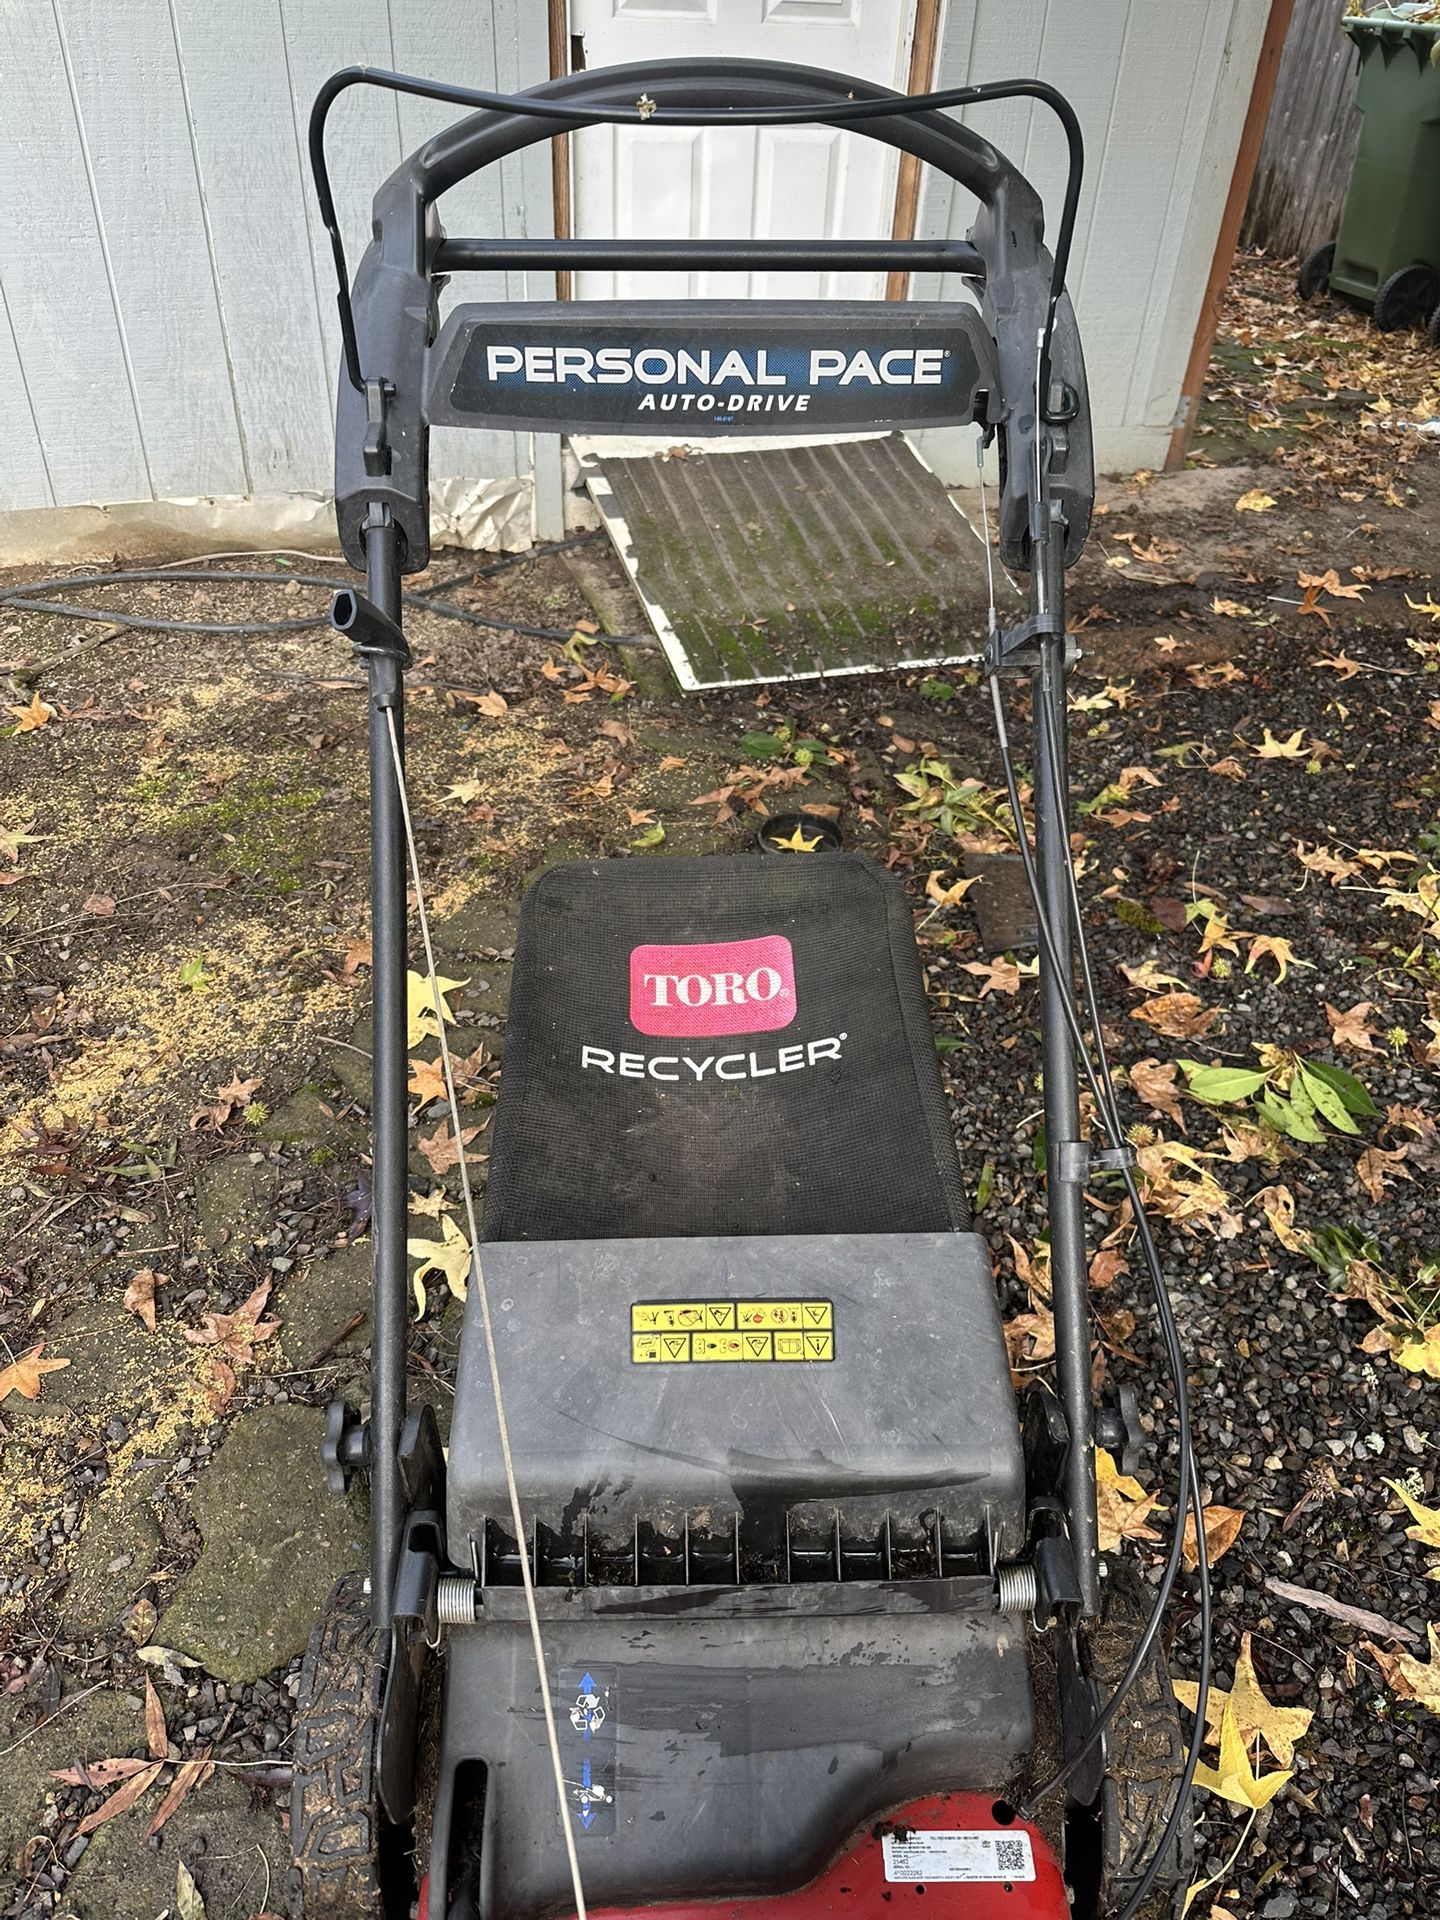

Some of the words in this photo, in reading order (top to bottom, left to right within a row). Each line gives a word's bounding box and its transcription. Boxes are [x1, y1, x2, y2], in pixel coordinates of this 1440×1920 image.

[486, 345, 787, 386] PERSONAL
[637, 393, 811, 412] AUTO-DRIVE
[643, 966, 782, 1007] TORO
[581, 1037, 843, 1081] RECYCLER
